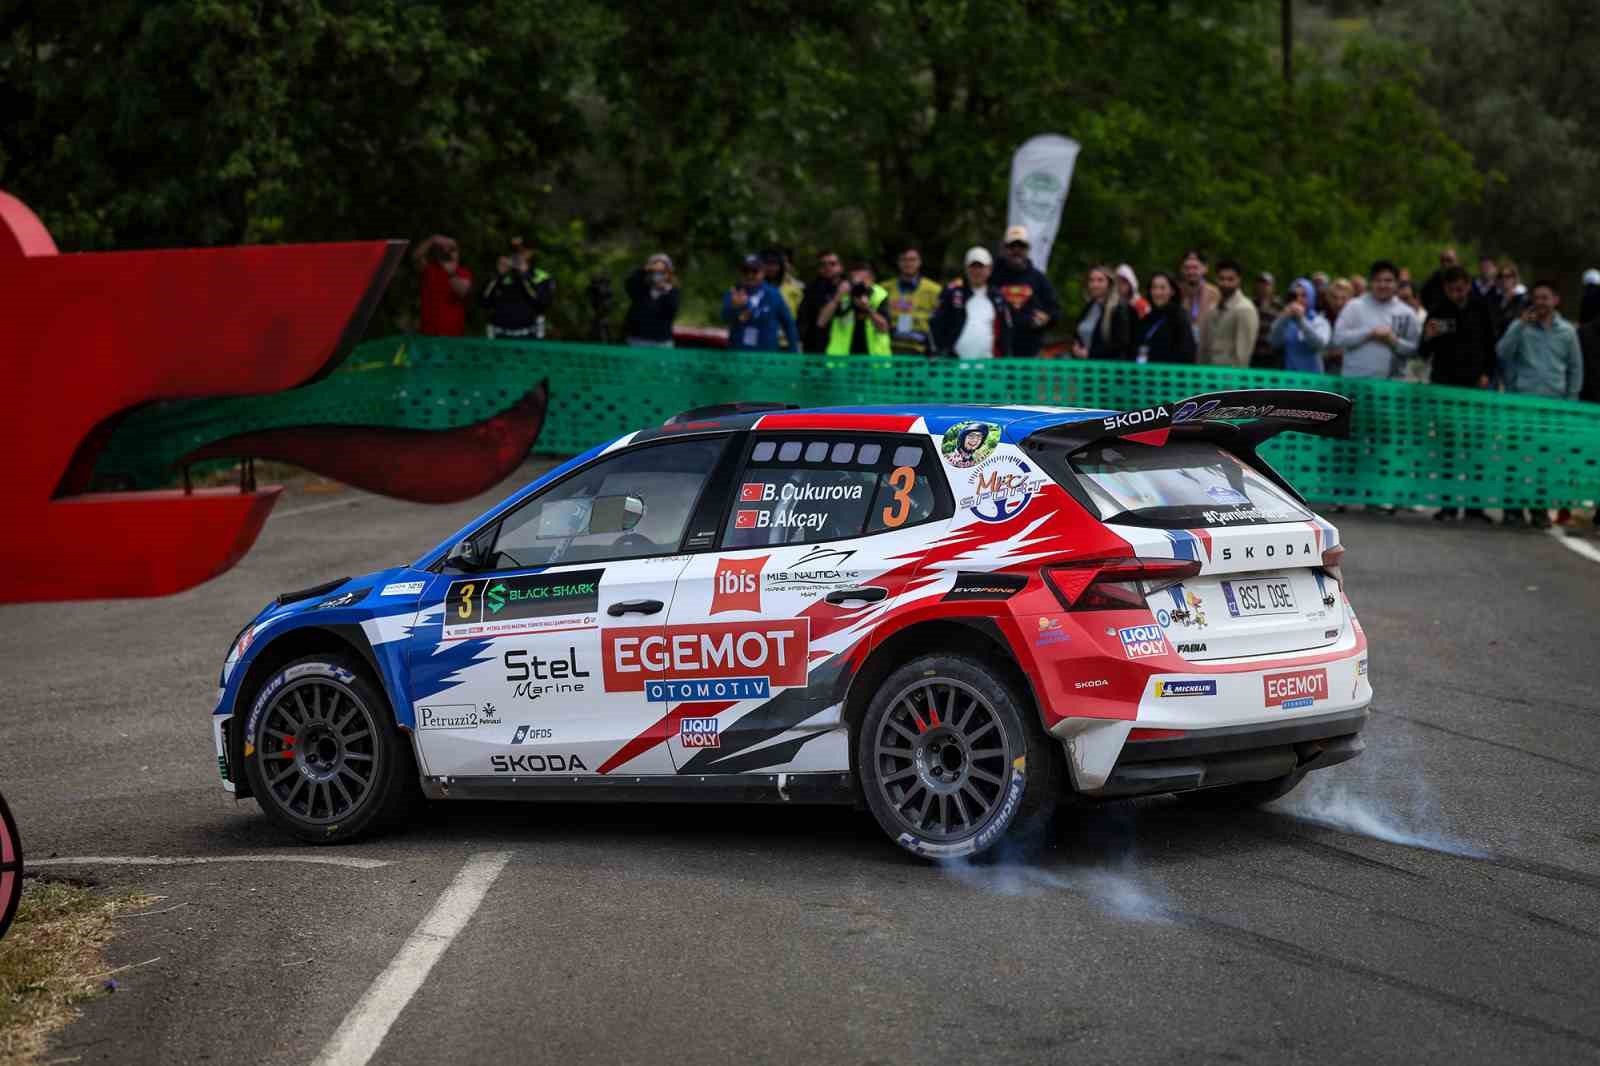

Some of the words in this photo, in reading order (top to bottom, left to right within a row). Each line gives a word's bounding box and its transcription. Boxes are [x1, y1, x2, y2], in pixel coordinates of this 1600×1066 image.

[883, 466, 915, 527] 3
[757, 510, 828, 531] B.Akçay
[719, 568, 756, 594] ibis
[794, 570, 841, 580] NAUTICA
[509, 587, 549, 600] BLACK
[552, 583, 594, 597] SHARK
[1239, 585, 1266, 610] 8SZ
[1267, 583, 1293, 608] D9E
[458, 584, 475, 619] 3
[1122, 627, 1160, 643] LIQUI
[614, 630, 795, 673] EGEMOT
[1127, 640, 1164, 657] MOLY
[1177, 643, 1208, 653] FABIA
[512, 681, 585, 700] Marine
[1267, 674, 1324, 698] EGEMOT
[420, 708, 478, 727] Petruzzi2
[682, 719, 716, 733] LIQUI
[529, 728, 553, 740] DFDS
[682, 732, 718, 747] MOLY
